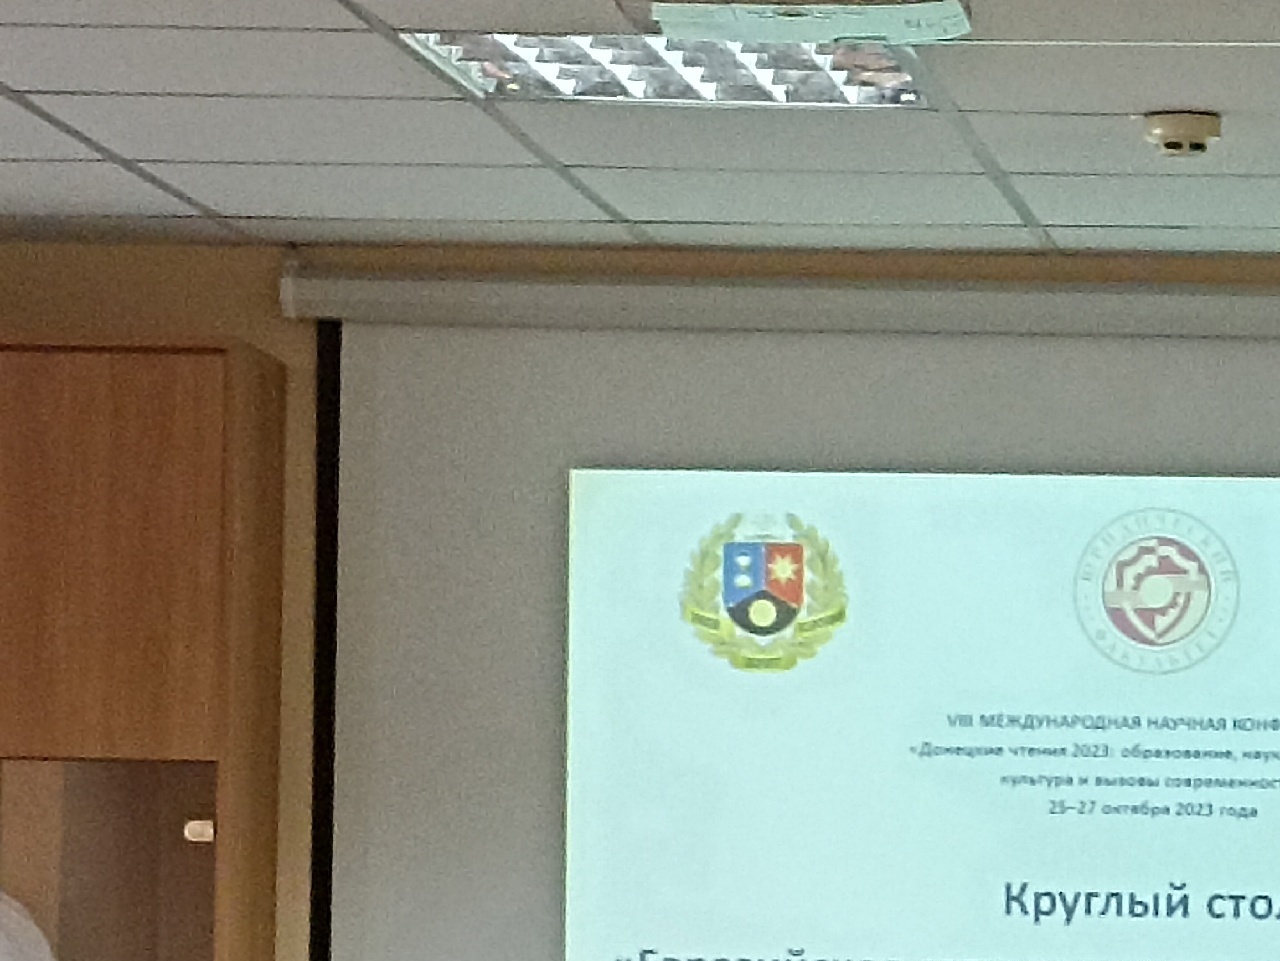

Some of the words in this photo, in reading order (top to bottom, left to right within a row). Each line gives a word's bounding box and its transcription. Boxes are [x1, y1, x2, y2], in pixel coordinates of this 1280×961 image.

[947, 714, 973, 728] VIII
[980, 714, 1142, 731] МЕЖДУНАРОДНАЯ
[1147, 716, 1227, 731] НАУЧНАЯ
[909, 741, 1003, 758] «Донецкие
[1008, 745, 1067, 757] чтения
[1121, 743, 1238, 761] образование,
[1000, 774, 1073, 788] культура
[1078, 776, 1090, 786] и
[1095, 776, 1160, 787] вызовы
[1101, 800, 1170, 818] октября
[1175, 802, 1214, 816] 2023
[1219, 805, 1258, 820] года
[1004, 881, 1190, 926] Круглый
